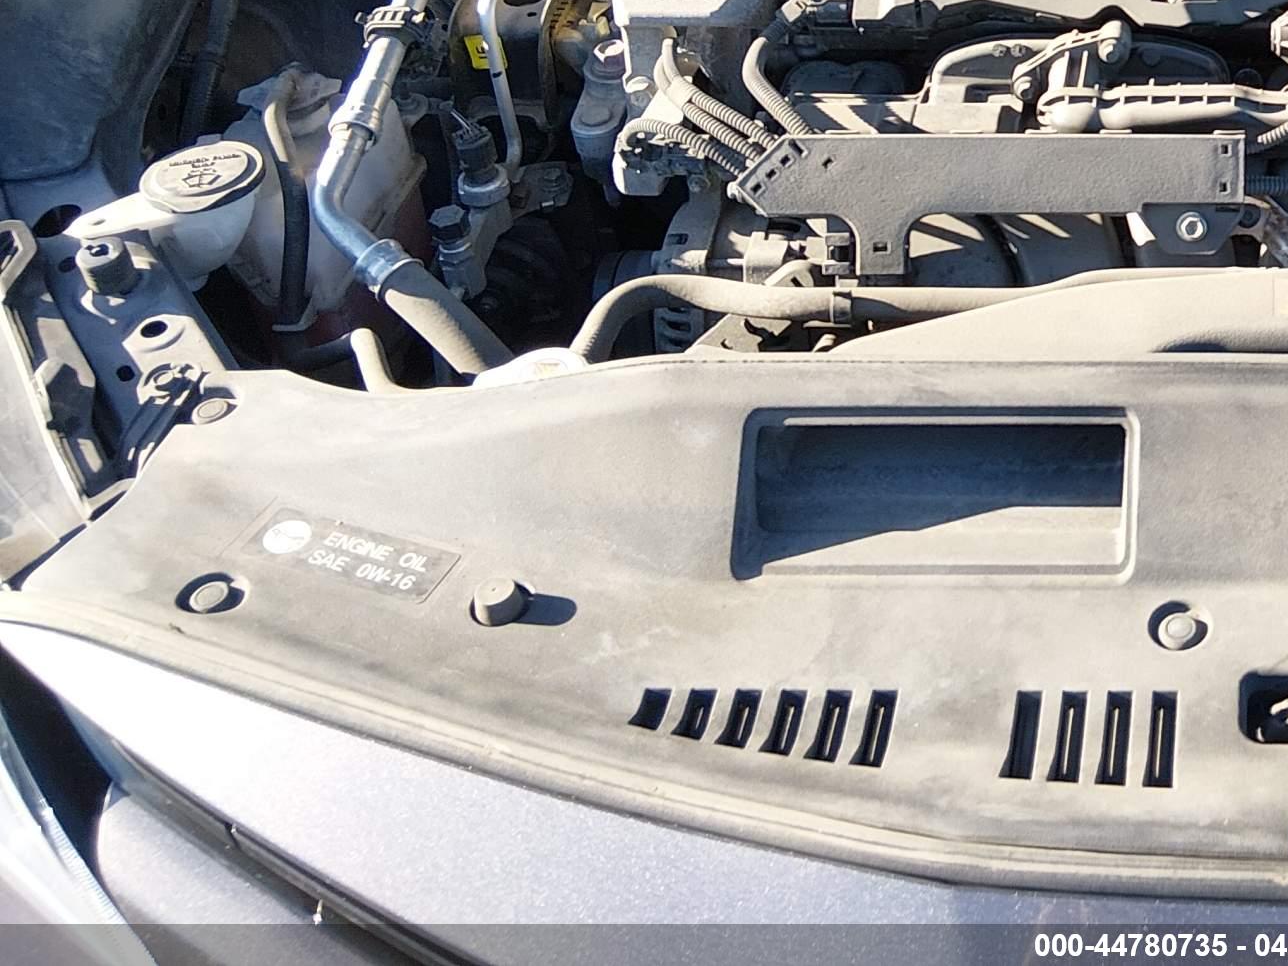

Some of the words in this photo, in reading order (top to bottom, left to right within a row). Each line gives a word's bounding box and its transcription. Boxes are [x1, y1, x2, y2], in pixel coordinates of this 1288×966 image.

[307, 549, 351, 572] SAE
[355, 563, 417, 591] 0W-16
[322, 531, 394, 562] ENGINE
[399, 552, 428, 572] OIL
